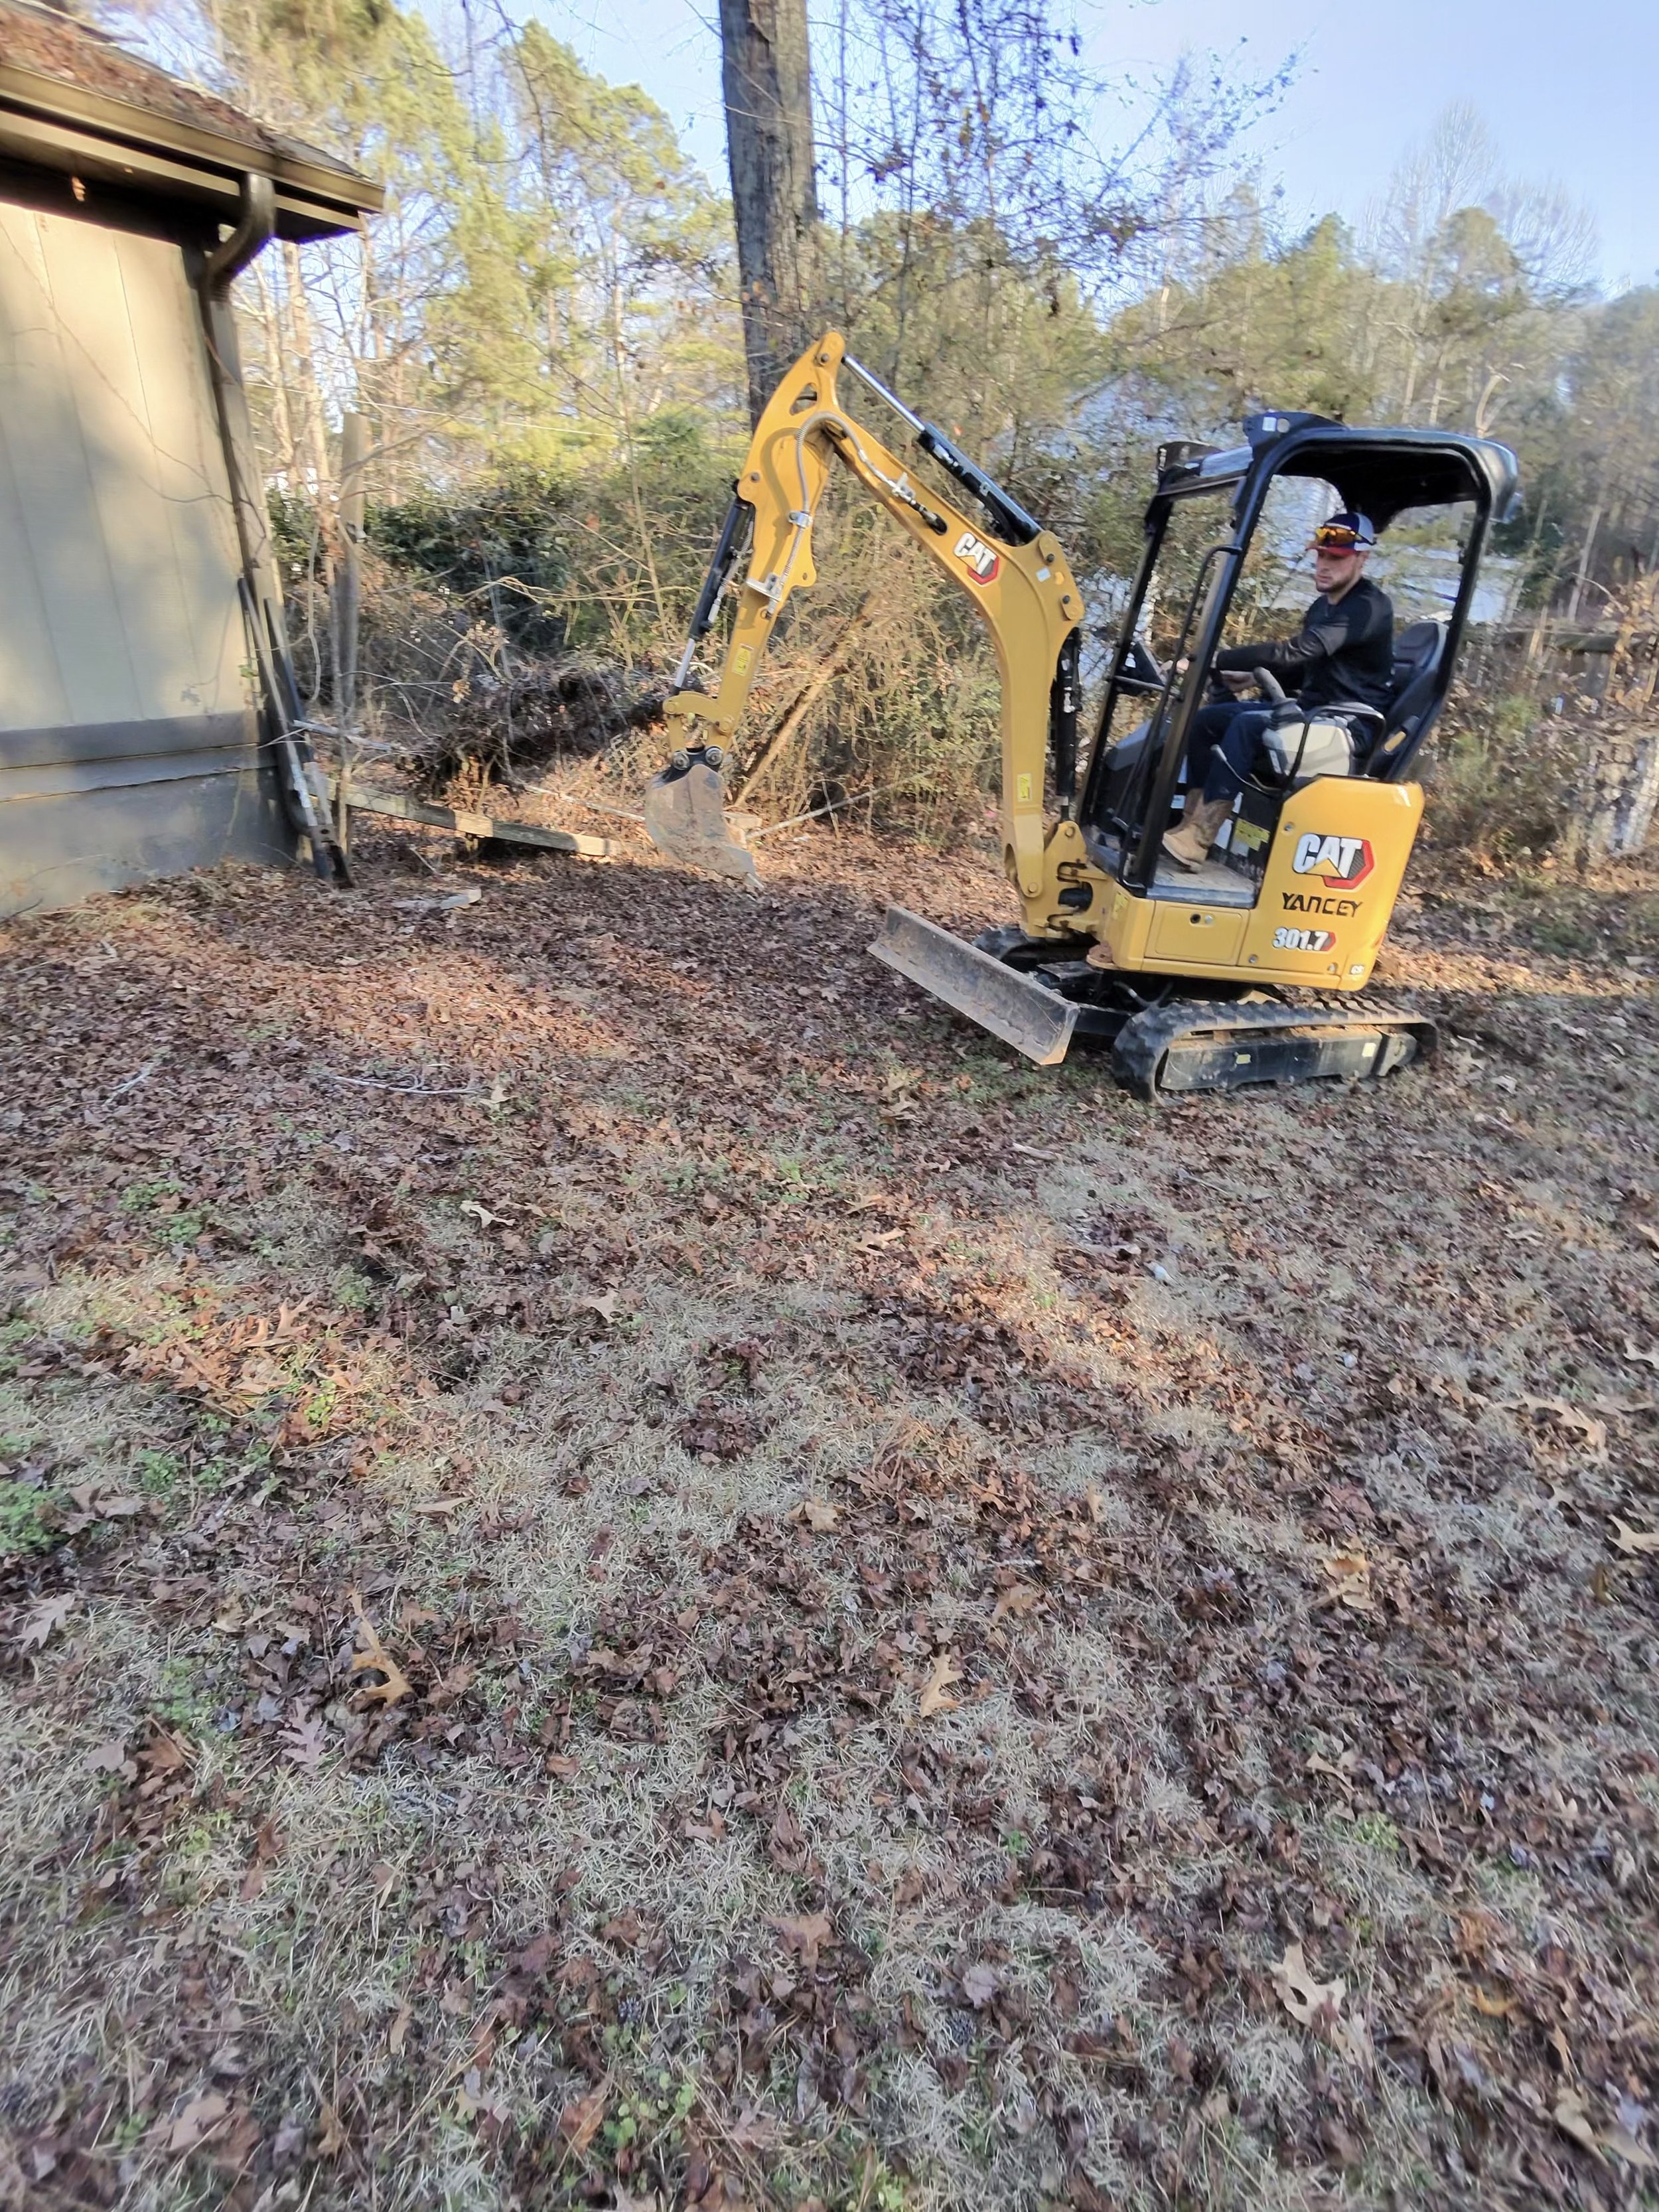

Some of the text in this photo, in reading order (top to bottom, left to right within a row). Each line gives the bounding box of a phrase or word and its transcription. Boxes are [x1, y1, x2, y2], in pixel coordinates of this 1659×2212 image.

[954, 532, 997, 575] CAT
[1293, 833, 1362, 879] CAT
[1282, 892, 1362, 917] YANCEY
[1273, 927, 1329, 950] 301.7
